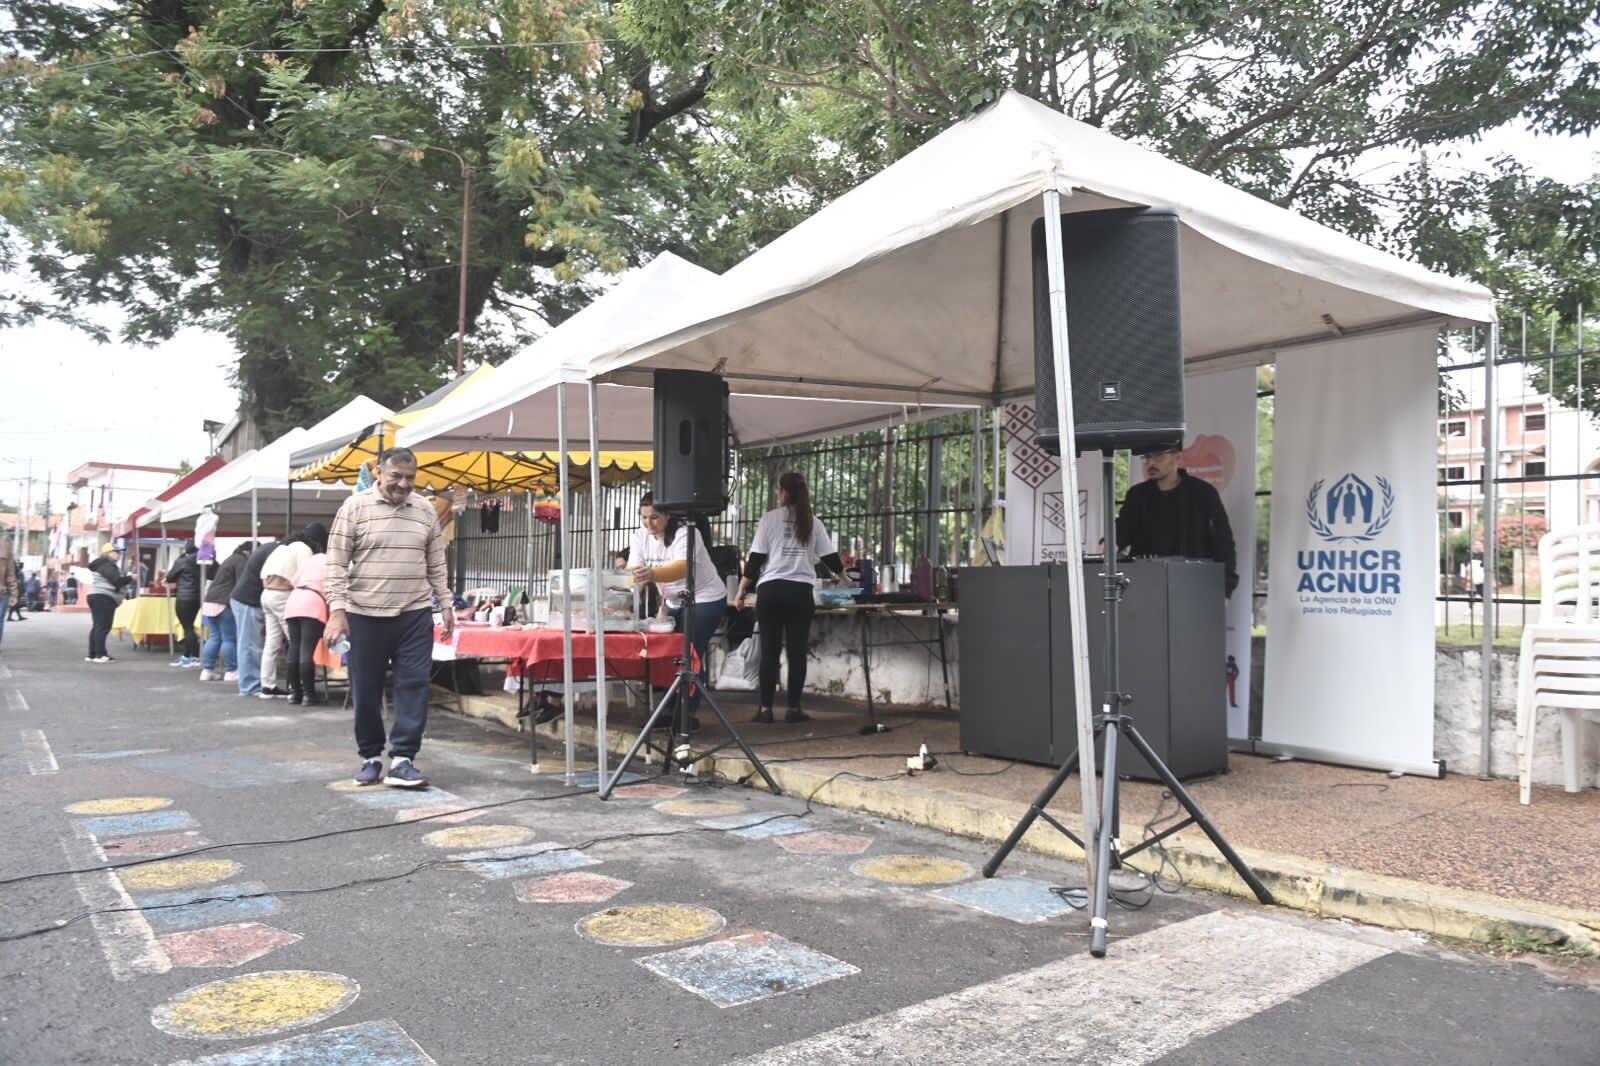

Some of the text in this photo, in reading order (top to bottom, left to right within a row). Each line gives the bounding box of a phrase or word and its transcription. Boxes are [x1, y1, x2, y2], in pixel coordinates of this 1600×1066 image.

[1297, 550, 1401, 570] UNHCR
[1297, 572, 1401, 594] ACNUR
[1300, 595, 1397, 605] La Agencia de la ONU
[1303, 606, 1393, 616] para los Refugiados
